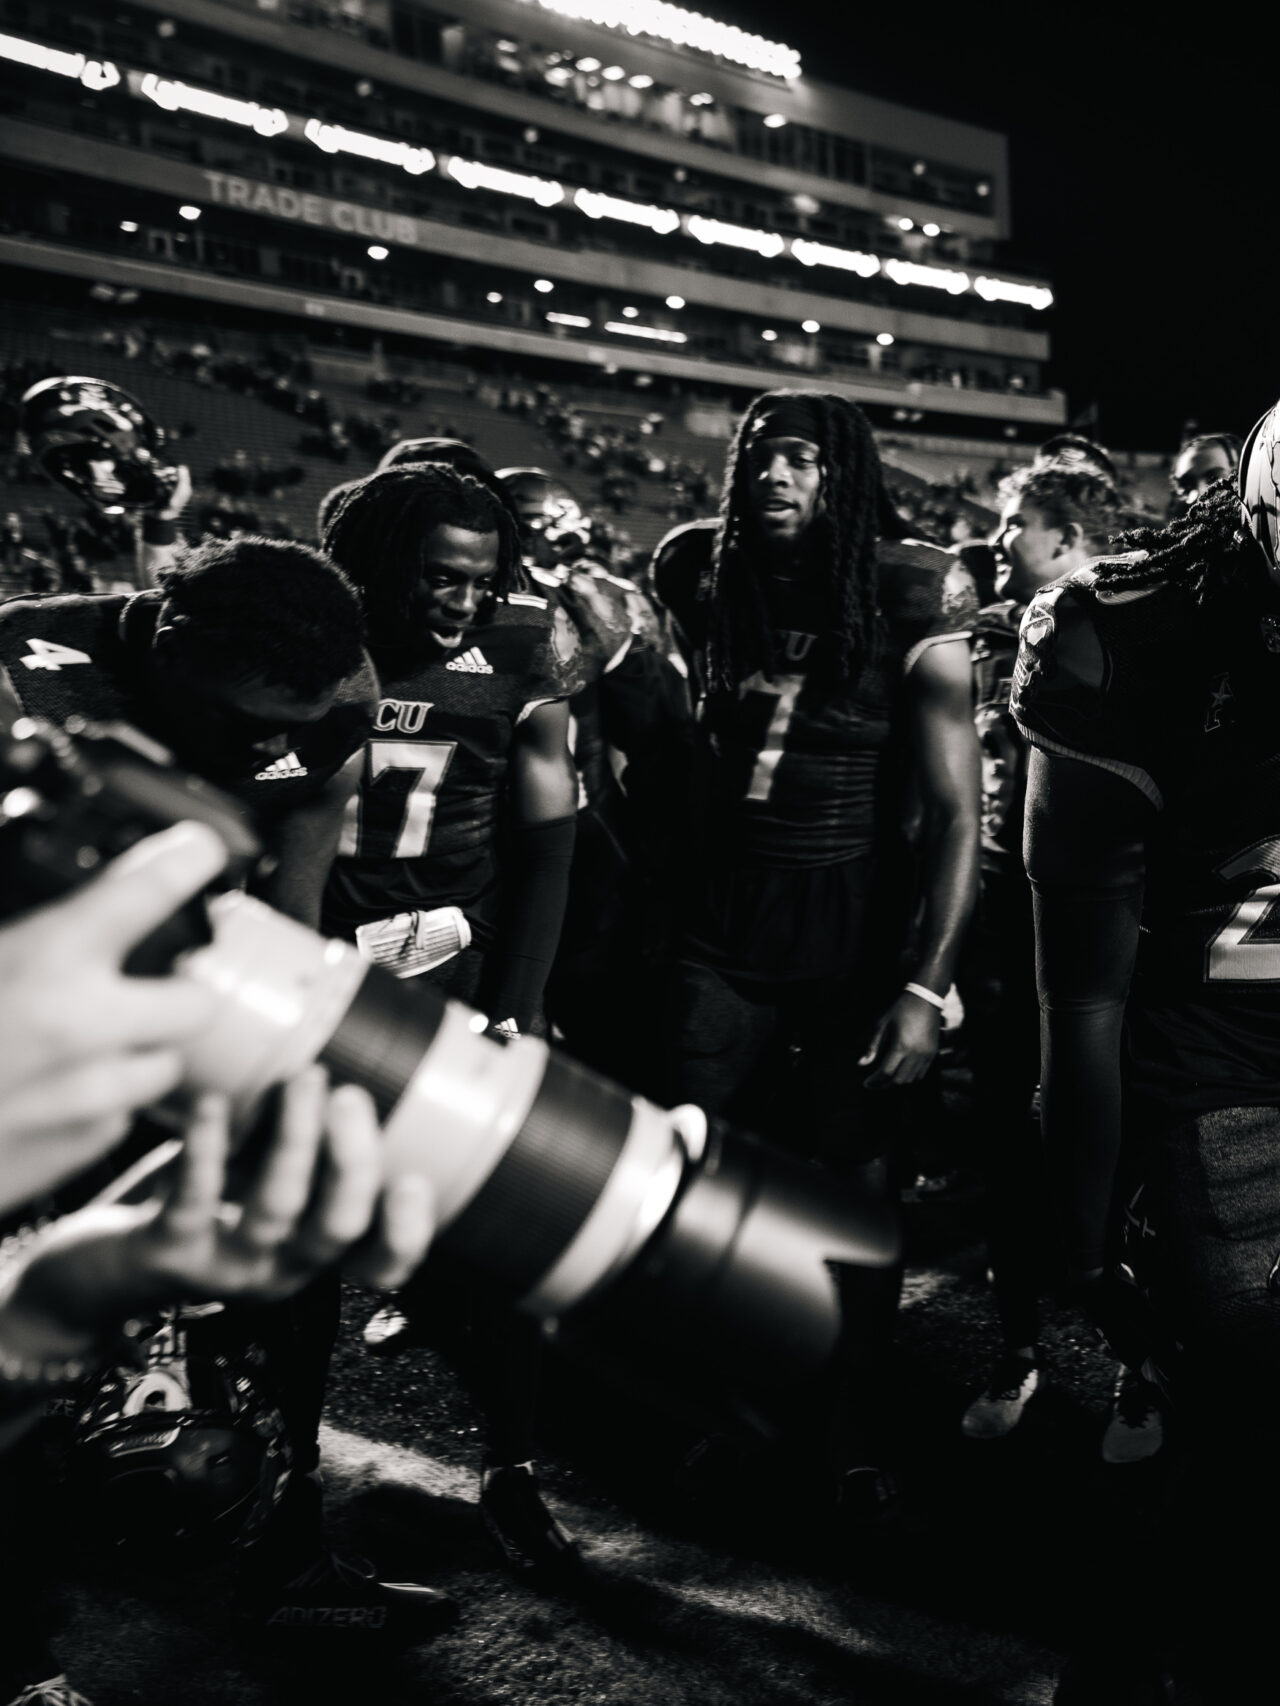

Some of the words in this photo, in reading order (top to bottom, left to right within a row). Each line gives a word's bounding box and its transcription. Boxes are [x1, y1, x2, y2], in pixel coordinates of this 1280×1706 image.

[203, 168, 326, 225] TRADE
[331, 199, 418, 244] CLUB
[19, 637, 93, 671] 4
[445, 660, 494, 675] adidas
[372, 698, 435, 734] CU
[254, 766, 308, 781] adidas
[266, 1605, 388, 1630] ADIZERO
